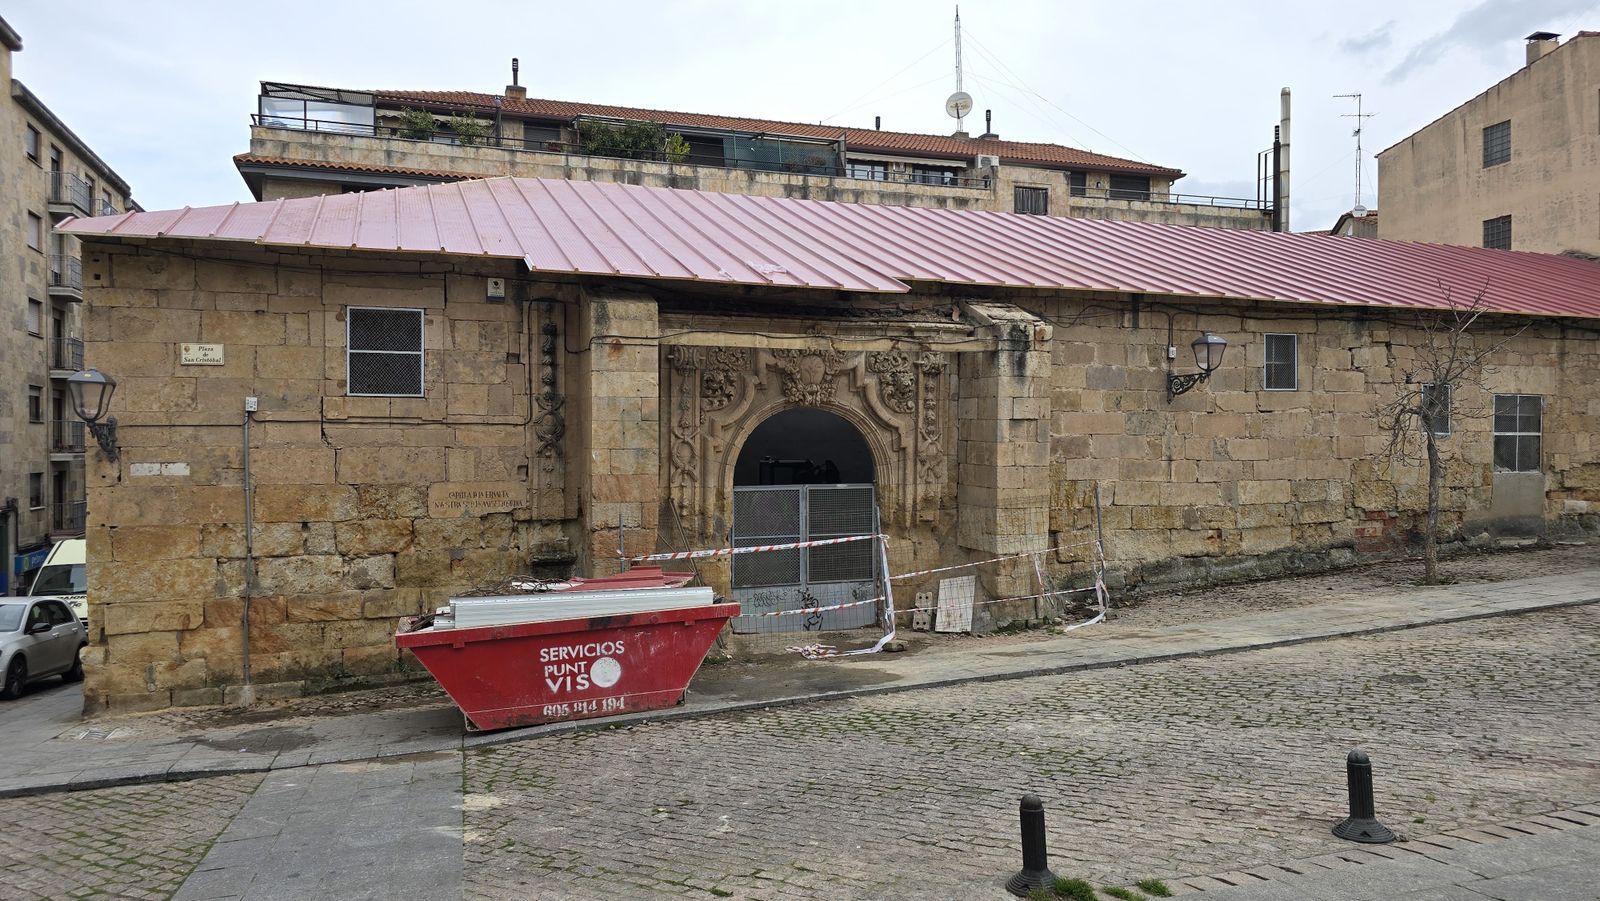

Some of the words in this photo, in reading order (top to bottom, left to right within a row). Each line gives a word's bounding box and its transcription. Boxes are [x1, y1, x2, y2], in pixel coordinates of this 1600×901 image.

[540, 641, 625, 662] SERVICIOS
[543, 704, 569, 716] 605
[573, 700, 598, 714] 814
[602, 697, 625, 711] 194
